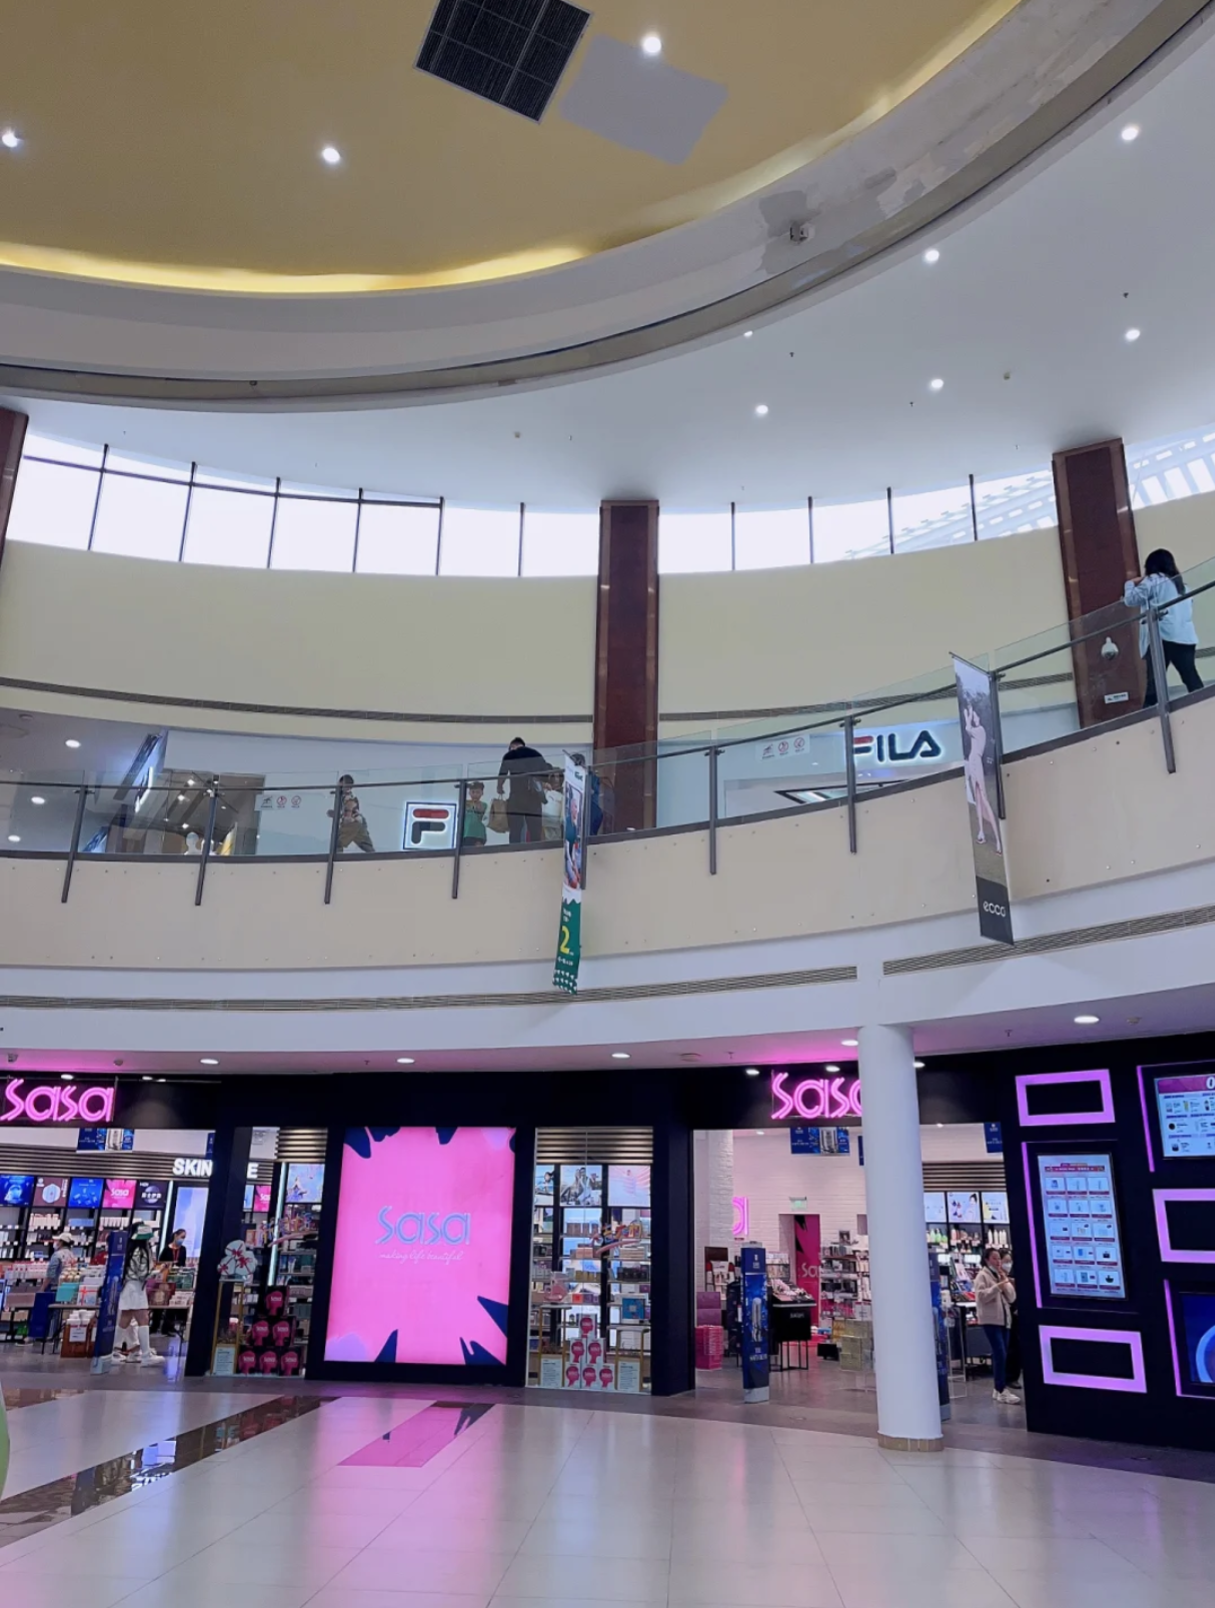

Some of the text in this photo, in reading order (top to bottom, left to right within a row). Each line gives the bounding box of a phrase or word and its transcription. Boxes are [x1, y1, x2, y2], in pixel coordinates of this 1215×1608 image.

[853, 730, 941, 762] FILA
[983, 900, 1006, 917] ecco
[560, 925, 570, 954] 2
[0, 1078, 115, 1122] Sasa
[375, 1205, 471, 1245] Sasa
[380, 1249, 408, 1264] making
[427, 1250, 464, 1265] beautiful
